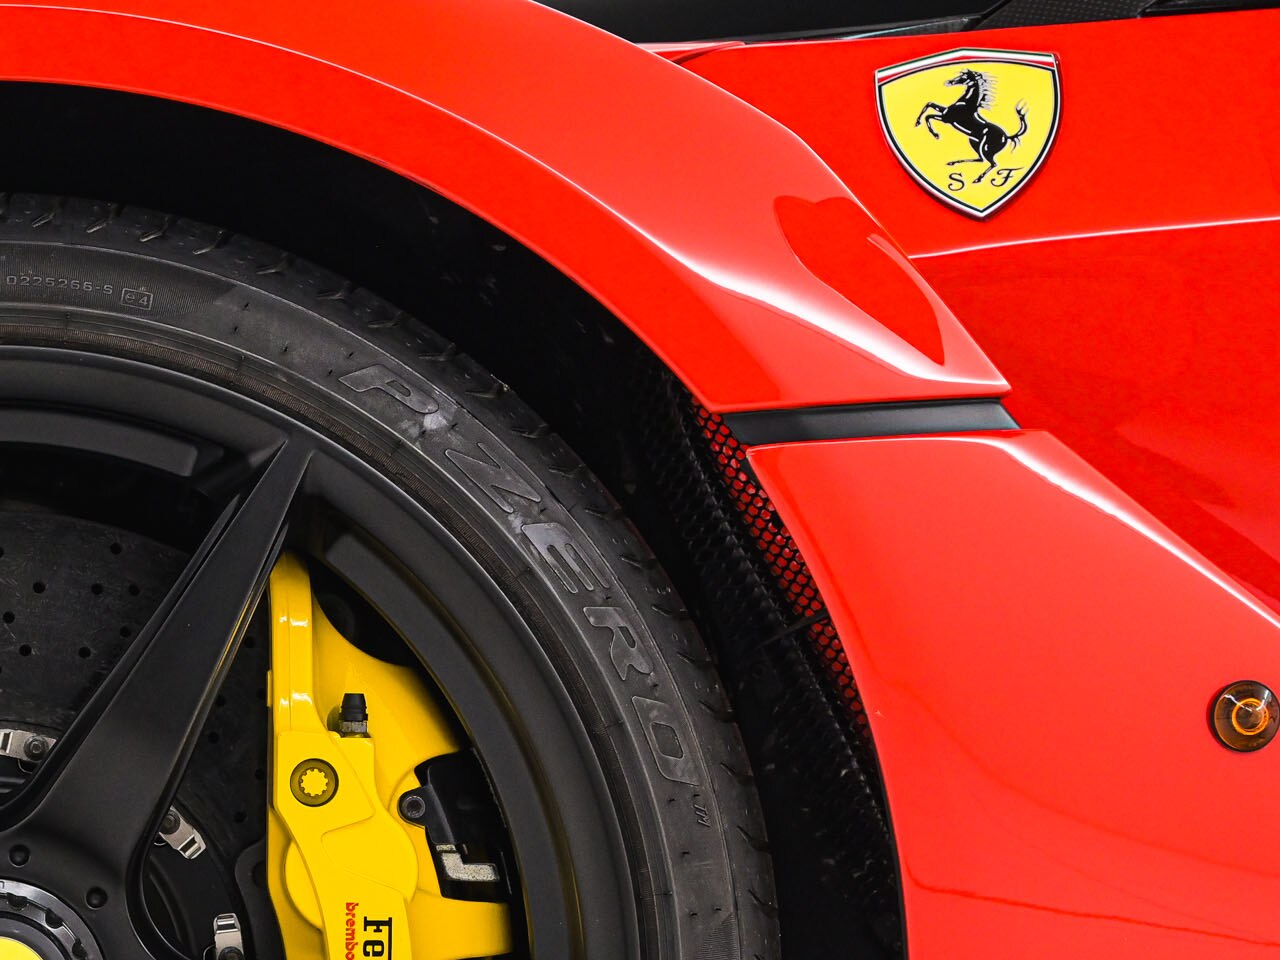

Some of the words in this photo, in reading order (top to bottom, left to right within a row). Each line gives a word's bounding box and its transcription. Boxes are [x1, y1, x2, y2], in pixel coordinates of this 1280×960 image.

[947, 172, 965, 192] S
[337, 362, 436, 412] P
[441, 435, 699, 784] ZERO
[345, 902, 359, 960] brembo
